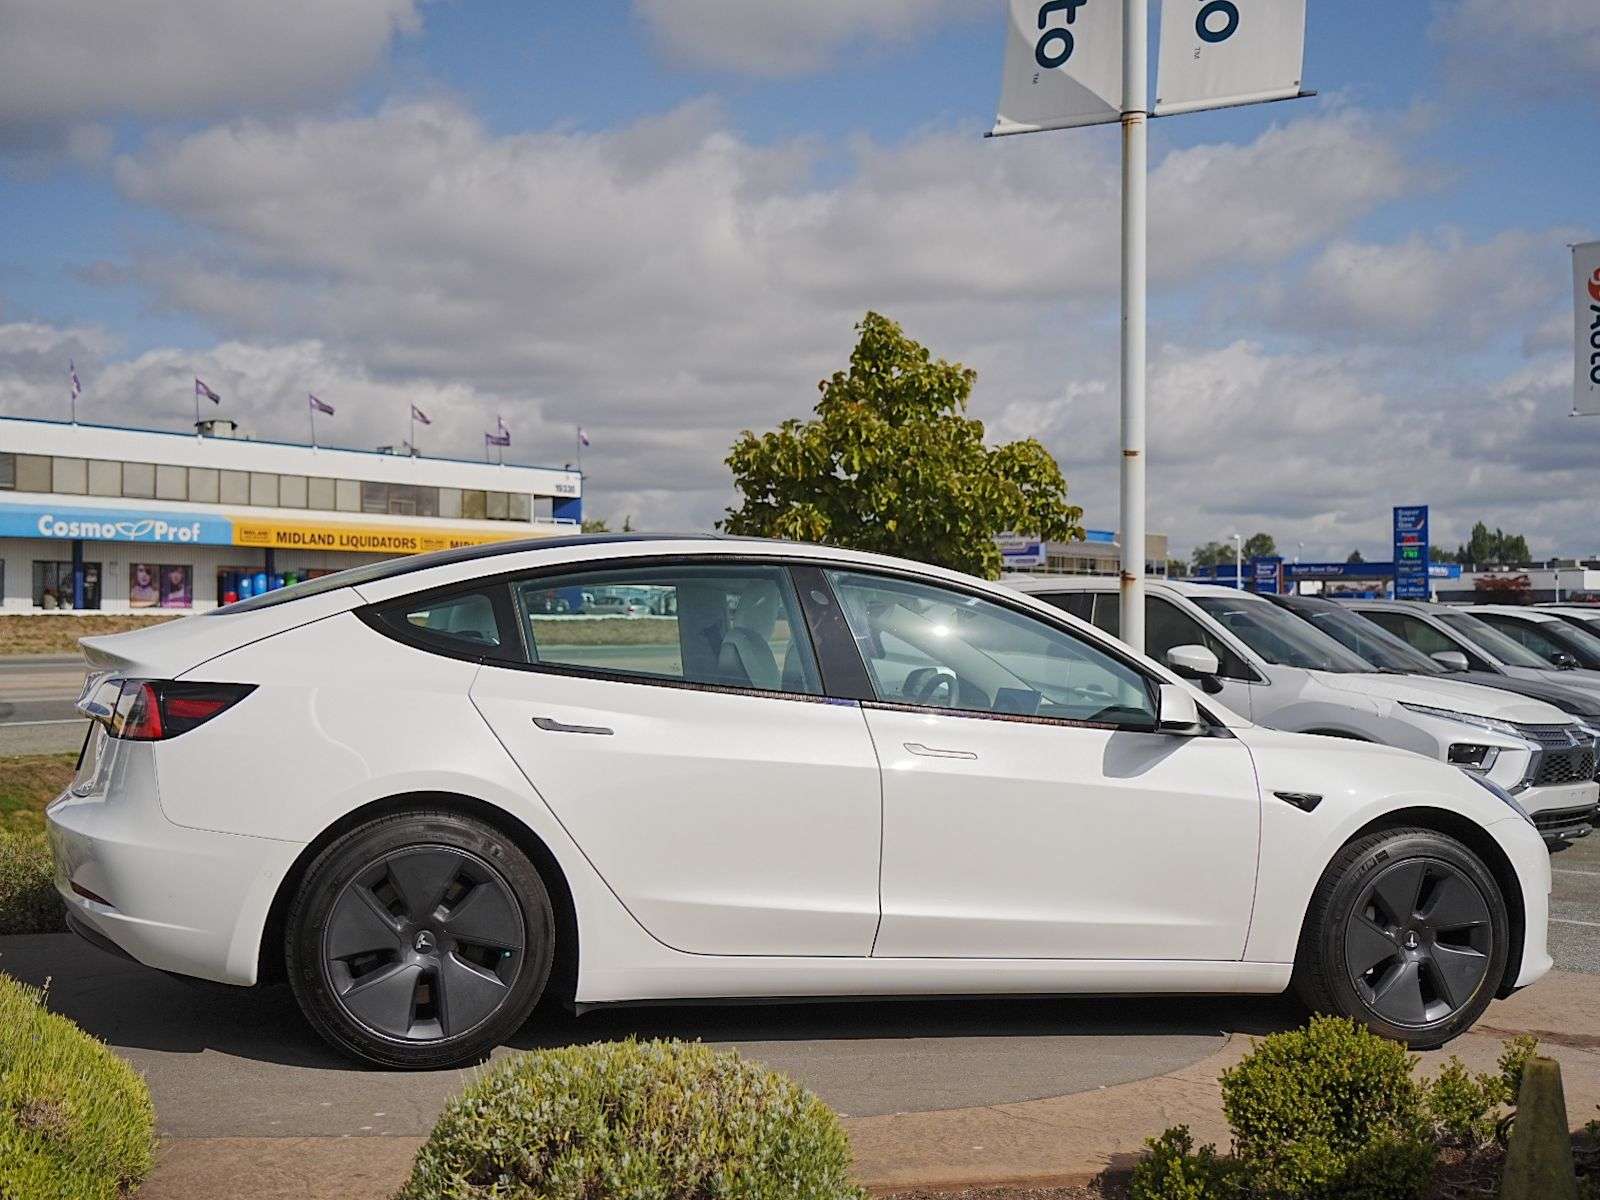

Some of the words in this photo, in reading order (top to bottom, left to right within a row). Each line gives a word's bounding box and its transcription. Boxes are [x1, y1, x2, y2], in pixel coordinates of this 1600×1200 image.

[1195, 0, 1239, 43] o
[38, 514, 117, 538] Cosmo
[154, 520, 200, 542] Prof
[276, 531, 336, 546] MIDLAND
[339, 534, 417, 550] LIQUIDATORS
